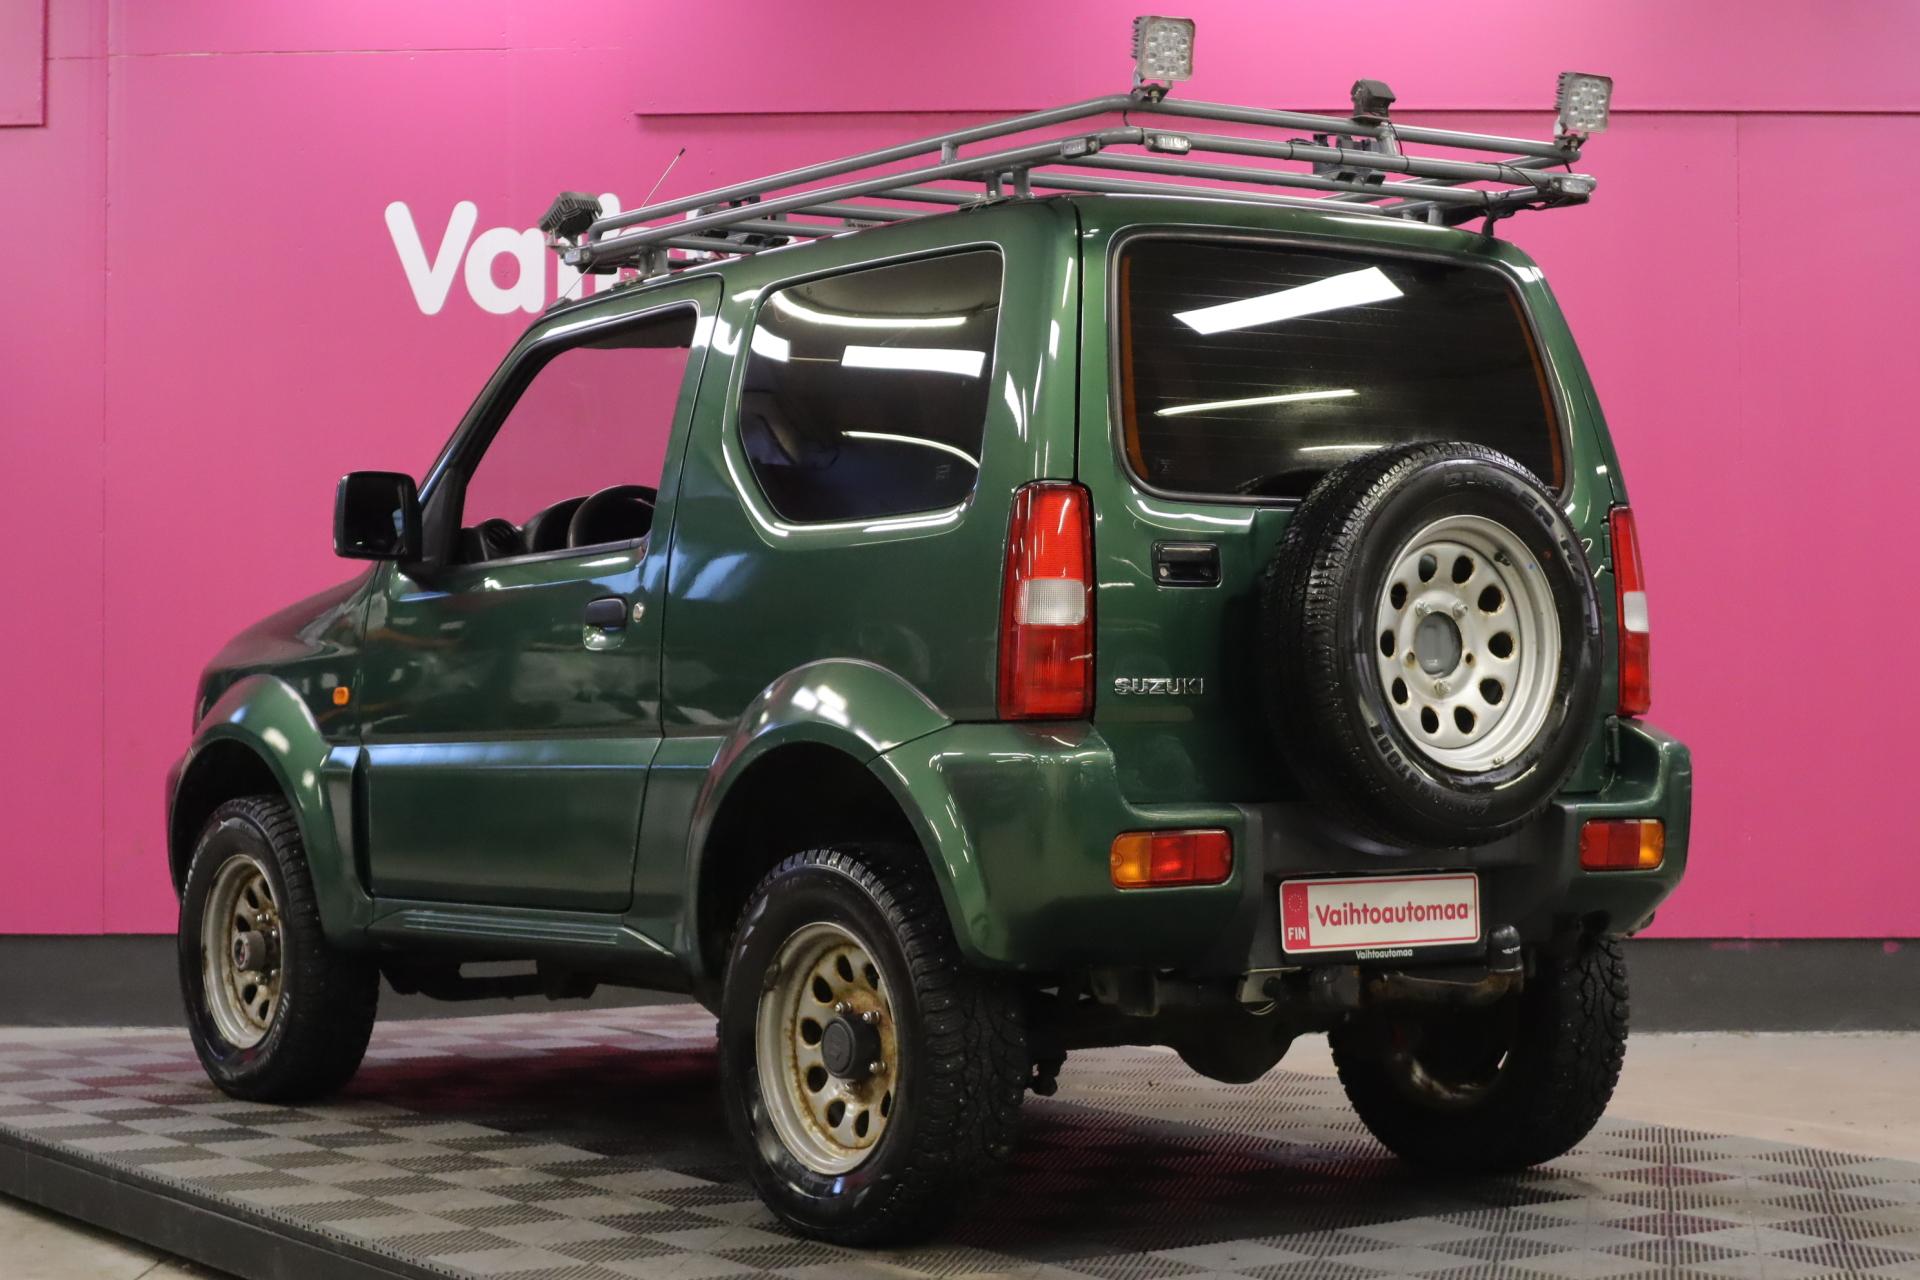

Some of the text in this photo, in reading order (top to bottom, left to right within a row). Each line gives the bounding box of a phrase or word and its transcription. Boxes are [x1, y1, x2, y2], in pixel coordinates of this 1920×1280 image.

[1114, 677, 1204, 695] SUZUKI
[1315, 901, 1469, 927] Vaihtoautomaa
[1287, 926, 1307, 941] FIN
[1355, 948, 1413, 960] Vaihtoautomaa
